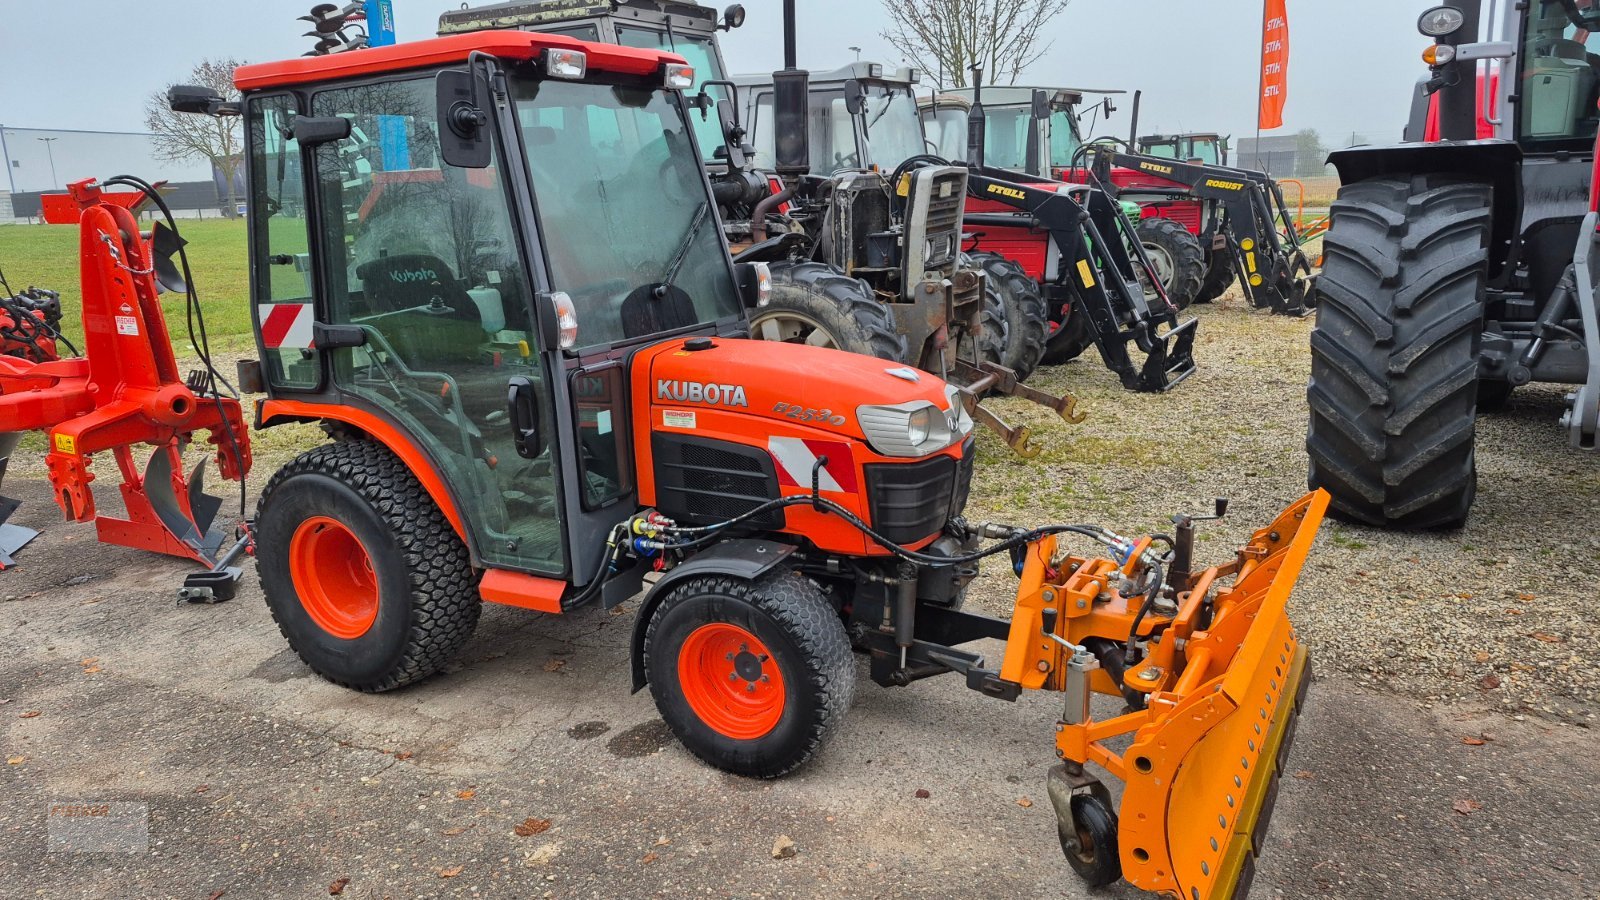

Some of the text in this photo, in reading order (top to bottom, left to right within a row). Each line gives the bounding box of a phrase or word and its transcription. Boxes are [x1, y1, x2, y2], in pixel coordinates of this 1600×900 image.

[1140, 161, 1172, 175] STOLL
[987, 184, 1025, 200] STOLL
[1205, 179, 1244, 191] ROBUST
[389, 267, 437, 283] Kubota
[657, 379, 748, 407] KUBOTA
